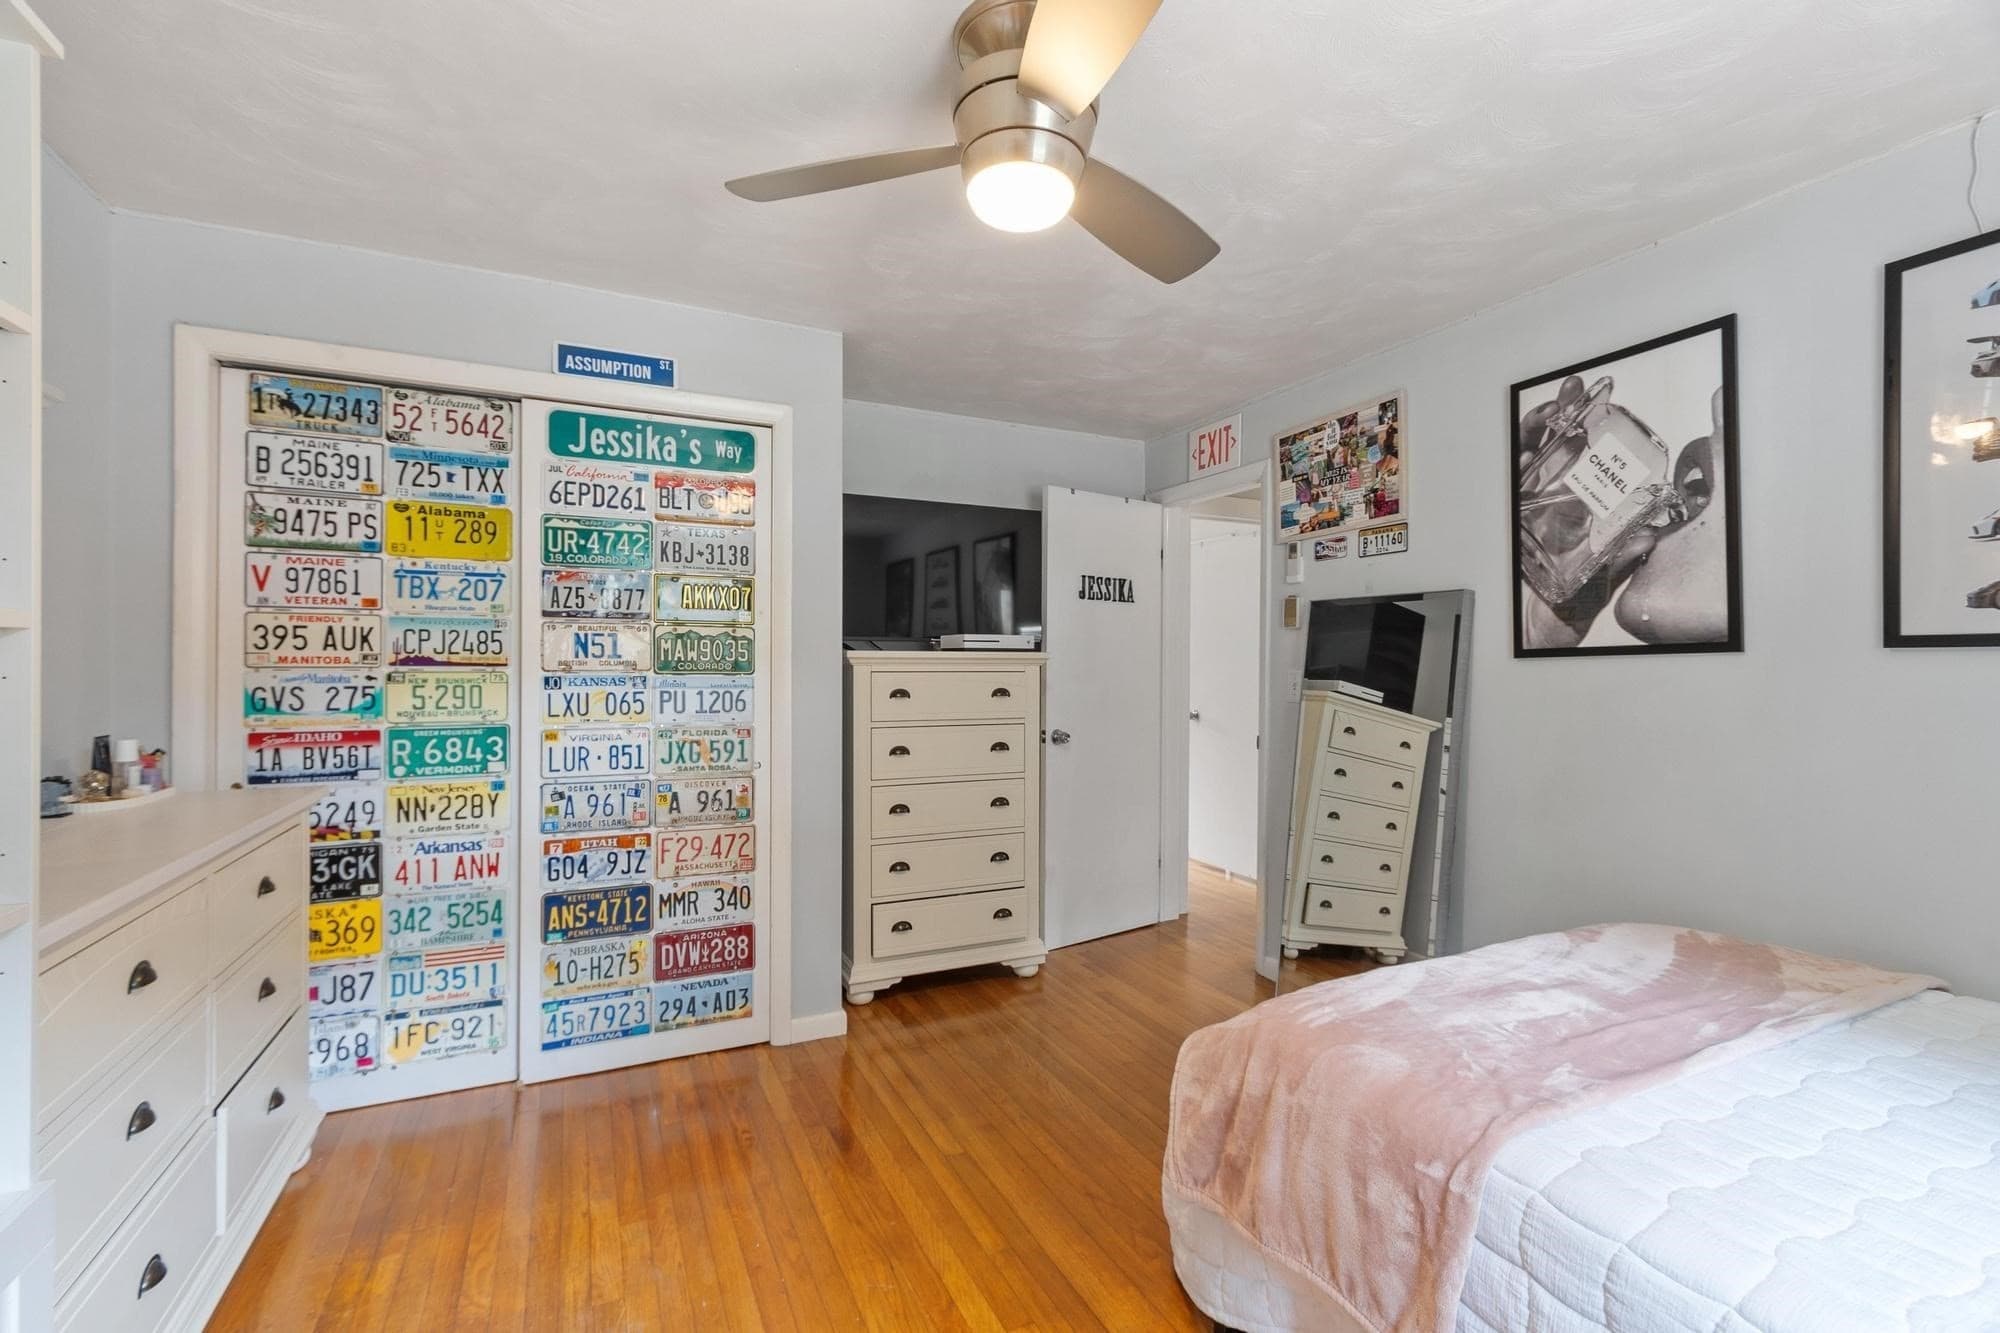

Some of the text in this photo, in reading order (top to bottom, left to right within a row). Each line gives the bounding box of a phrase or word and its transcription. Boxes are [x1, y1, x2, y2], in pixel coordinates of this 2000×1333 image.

[565, 355, 672, 380] ASSUMPTION ST.
[303, 393, 378, 425] 27343
[424, 396, 481, 410] Alabama
[296, 420, 338, 432] TRUCK
[393, 404, 504, 439] 52 5642
[293, 439, 341, 451] MAINE
[568, 417, 742, 464] Jessika's Way
[1198, 425, 1231, 470] EXIT
[256, 446, 373, 481] B 256391
[565, 465, 628, 481] California
[1590, 455, 1627, 494] CHANEL
[289, 477, 345, 489] TRAILER
[395, 461, 504, 493] 725 TXX
[287, 497, 348, 507] MAINE
[550, 480, 646, 511] 6EPD261
[659, 487, 694, 510] BLT
[273, 508, 377, 539] 9475 PS
[418, 505, 486, 519] Alabama
[406, 516, 497, 544] 11 289
[688, 528, 726, 538] TEXAS
[286, 557, 345, 566] MAINE
[567, 555, 628, 564] COLORADO
[660, 541, 749, 566] KBJ 3138
[425, 562, 477, 571] Kentucky
[251, 565, 360, 595] V 97861
[394, 575, 503, 602] TBX 207
[1079, 575, 1134, 603] JESSIKA
[285, 597, 347, 605] VETERAN
[551, 586, 584, 609] AZ5
[253, 624, 374, 652] 395 AUK
[574, 633, 622, 659] N51
[277, 655, 351, 665] MANITOBA
[660, 639, 748, 661] MAW9035
[678, 662, 732, 670] COLORADO
[568, 677, 626, 686] KANSAS
[659, 680, 686, 688] Illinois
[252, 686, 376, 712] GVS 275
[548, 692, 645, 717] LXU 065
[659, 689, 746, 714] PU 1206
[294, 733, 343, 743] IDAHO
[255, 748, 282, 772] 1A
[549, 745, 644, 772] LUR 851
[709, 740, 748, 763] 591
[415, 765, 483, 775] VERMONT
[448, 784, 477, 794] Jersey
[397, 797, 427, 823] NN
[564, 793, 625, 819] A 961
[669, 792, 680, 814] A
[418, 823, 480, 833] Garden State
[567, 819, 627, 828] RHODE ISLAND
[414, 840, 482, 856] Arkansas
[580, 839, 617, 849] UTAH
[395, 853, 500, 885] 411 ANW
[607, 850, 646, 875] 9JZ
[675, 861, 738, 871] MASSACHUSETTS
[568, 889, 628, 902] KEYSTONE STATE
[691, 880, 720, 888] HAWAII
[659, 886, 750, 919] MMR 340
[389, 899, 503, 935] 342 5254
[681, 917, 705, 925] ALOHA
[326, 916, 375, 947] 369
[568, 925, 627, 937] PENNSYLVANIA
[683, 930, 727, 941] ARIZONA
[570, 942, 625, 956] NEBRASKA
[662, 935, 748, 970] DVW 288
[554, 951, 639, 986] 10-H275
[322, 971, 374, 1005] J87
[681, 978, 728, 992] NEVADA
[660, 996, 696, 1023] 294
[570, 1032, 623, 1045] INDIANA
